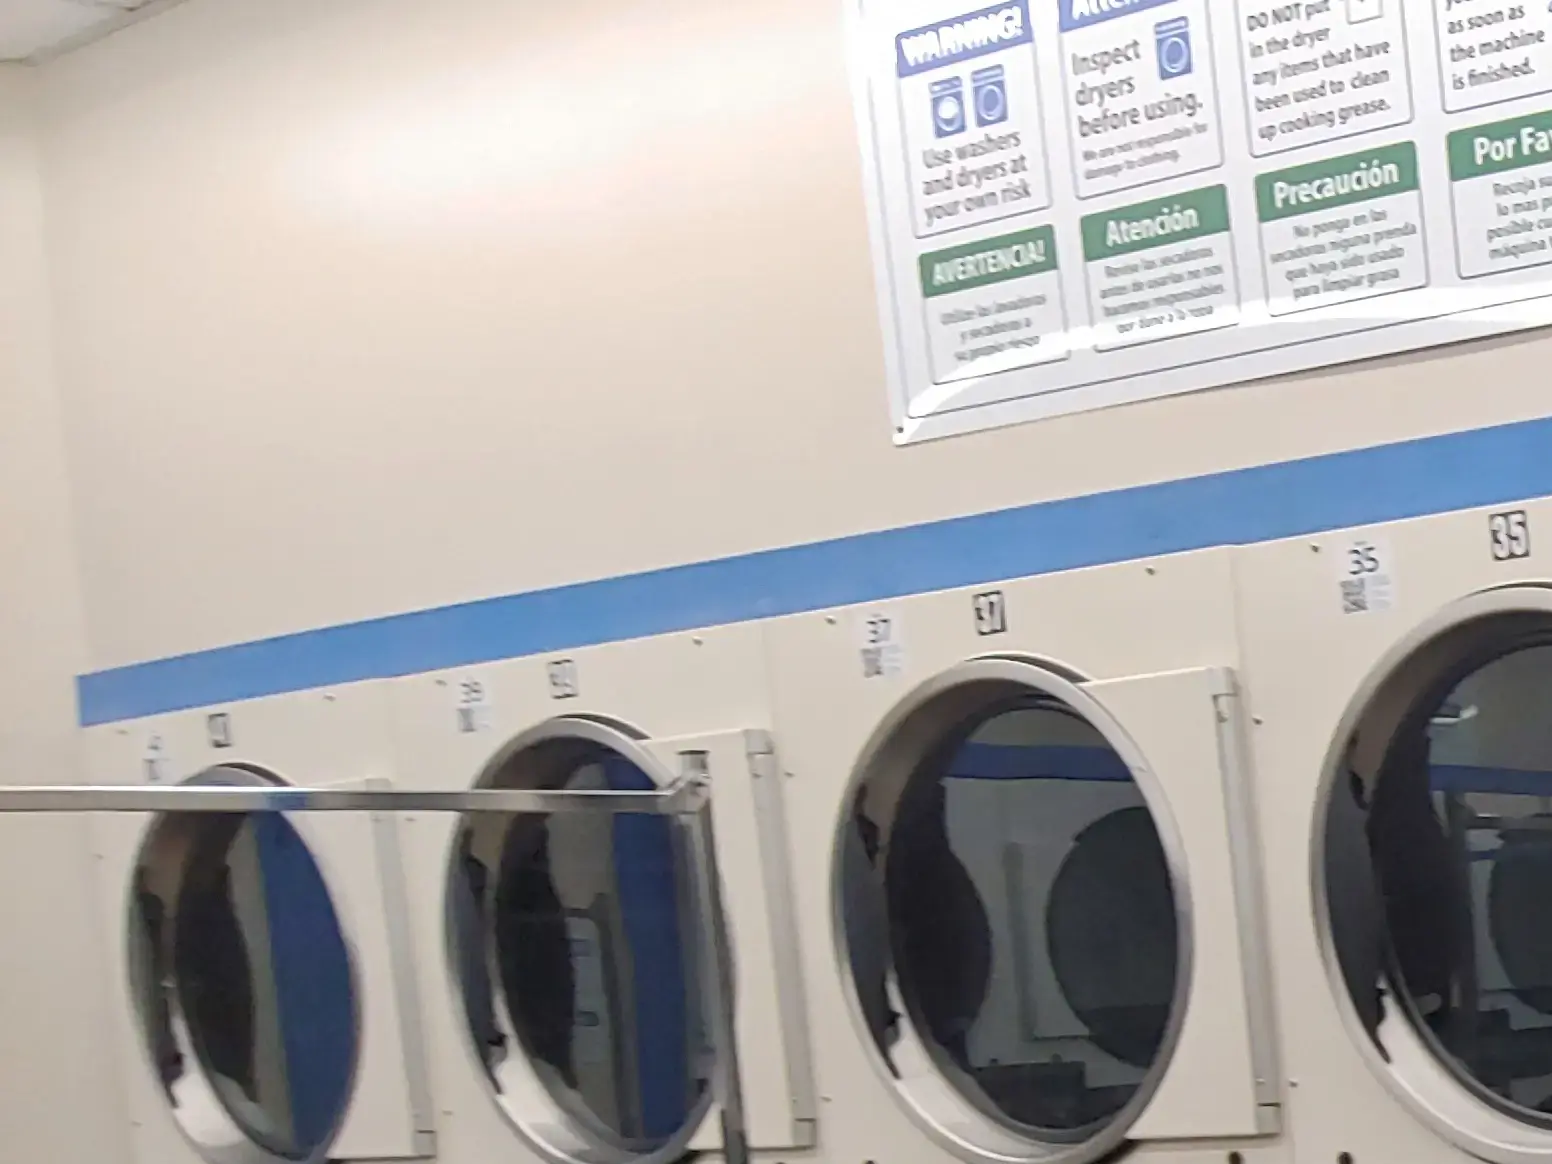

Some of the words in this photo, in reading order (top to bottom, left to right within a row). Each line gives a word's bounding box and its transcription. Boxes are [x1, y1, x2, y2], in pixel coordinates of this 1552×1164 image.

[1247, 12, 1268, 31] DO
[1272, 3, 1300, 25] NOT
[1448, 20, 1464, 34] as
[1467, 11, 1504, 30] soon
[1508, 5, 1525, 20] as
[1072, 39, 1141, 75] Inspect
[1249, 42, 1263, 58] in
[1266, 37, 1289, 53] the
[1292, 27, 1330, 48] dryer
[1450, 43, 1475, 62] the
[1479, 29, 1545, 55] machine
[1253, 70, 1277, 86] any
[1280, 58, 1319, 78] items
[1322, 48, 1353, 68] that
[1354, 41, 1390, 60] have
[1452, 73, 1465, 90] is
[1468, 56, 1535, 86] finished.
[1075, 76, 1135, 107] dryers
[1255, 94, 1291, 111] been
[1293, 80, 1327, 102] used
[1329, 80, 1345, 94] to
[1350, 70, 1389, 89] clean
[1078, 108, 1141, 137] before
[1144, 92, 1203, 120] using.
[1258, 125, 1276, 141] up
[1279, 111, 1335, 134] cooking
[1338, 99, 1391, 124] grease.
[923, 149, 952, 168] Use
[955, 131, 1021, 160] washers
[1473, 137, 1516, 165] Por
[923, 169, 953, 195] and
[957, 162, 1007, 189] dryers
[1011, 154, 1028, 173] at
[1274, 159, 1399, 209] Precaución
[925, 201, 960, 227] your
[965, 191, 998, 211] own
[1001, 178, 1031, 202] risk
[1106, 204, 1199, 247] Atención
[1490, 512, 1530, 560] 35
[1349, 546, 1379, 575] 35
